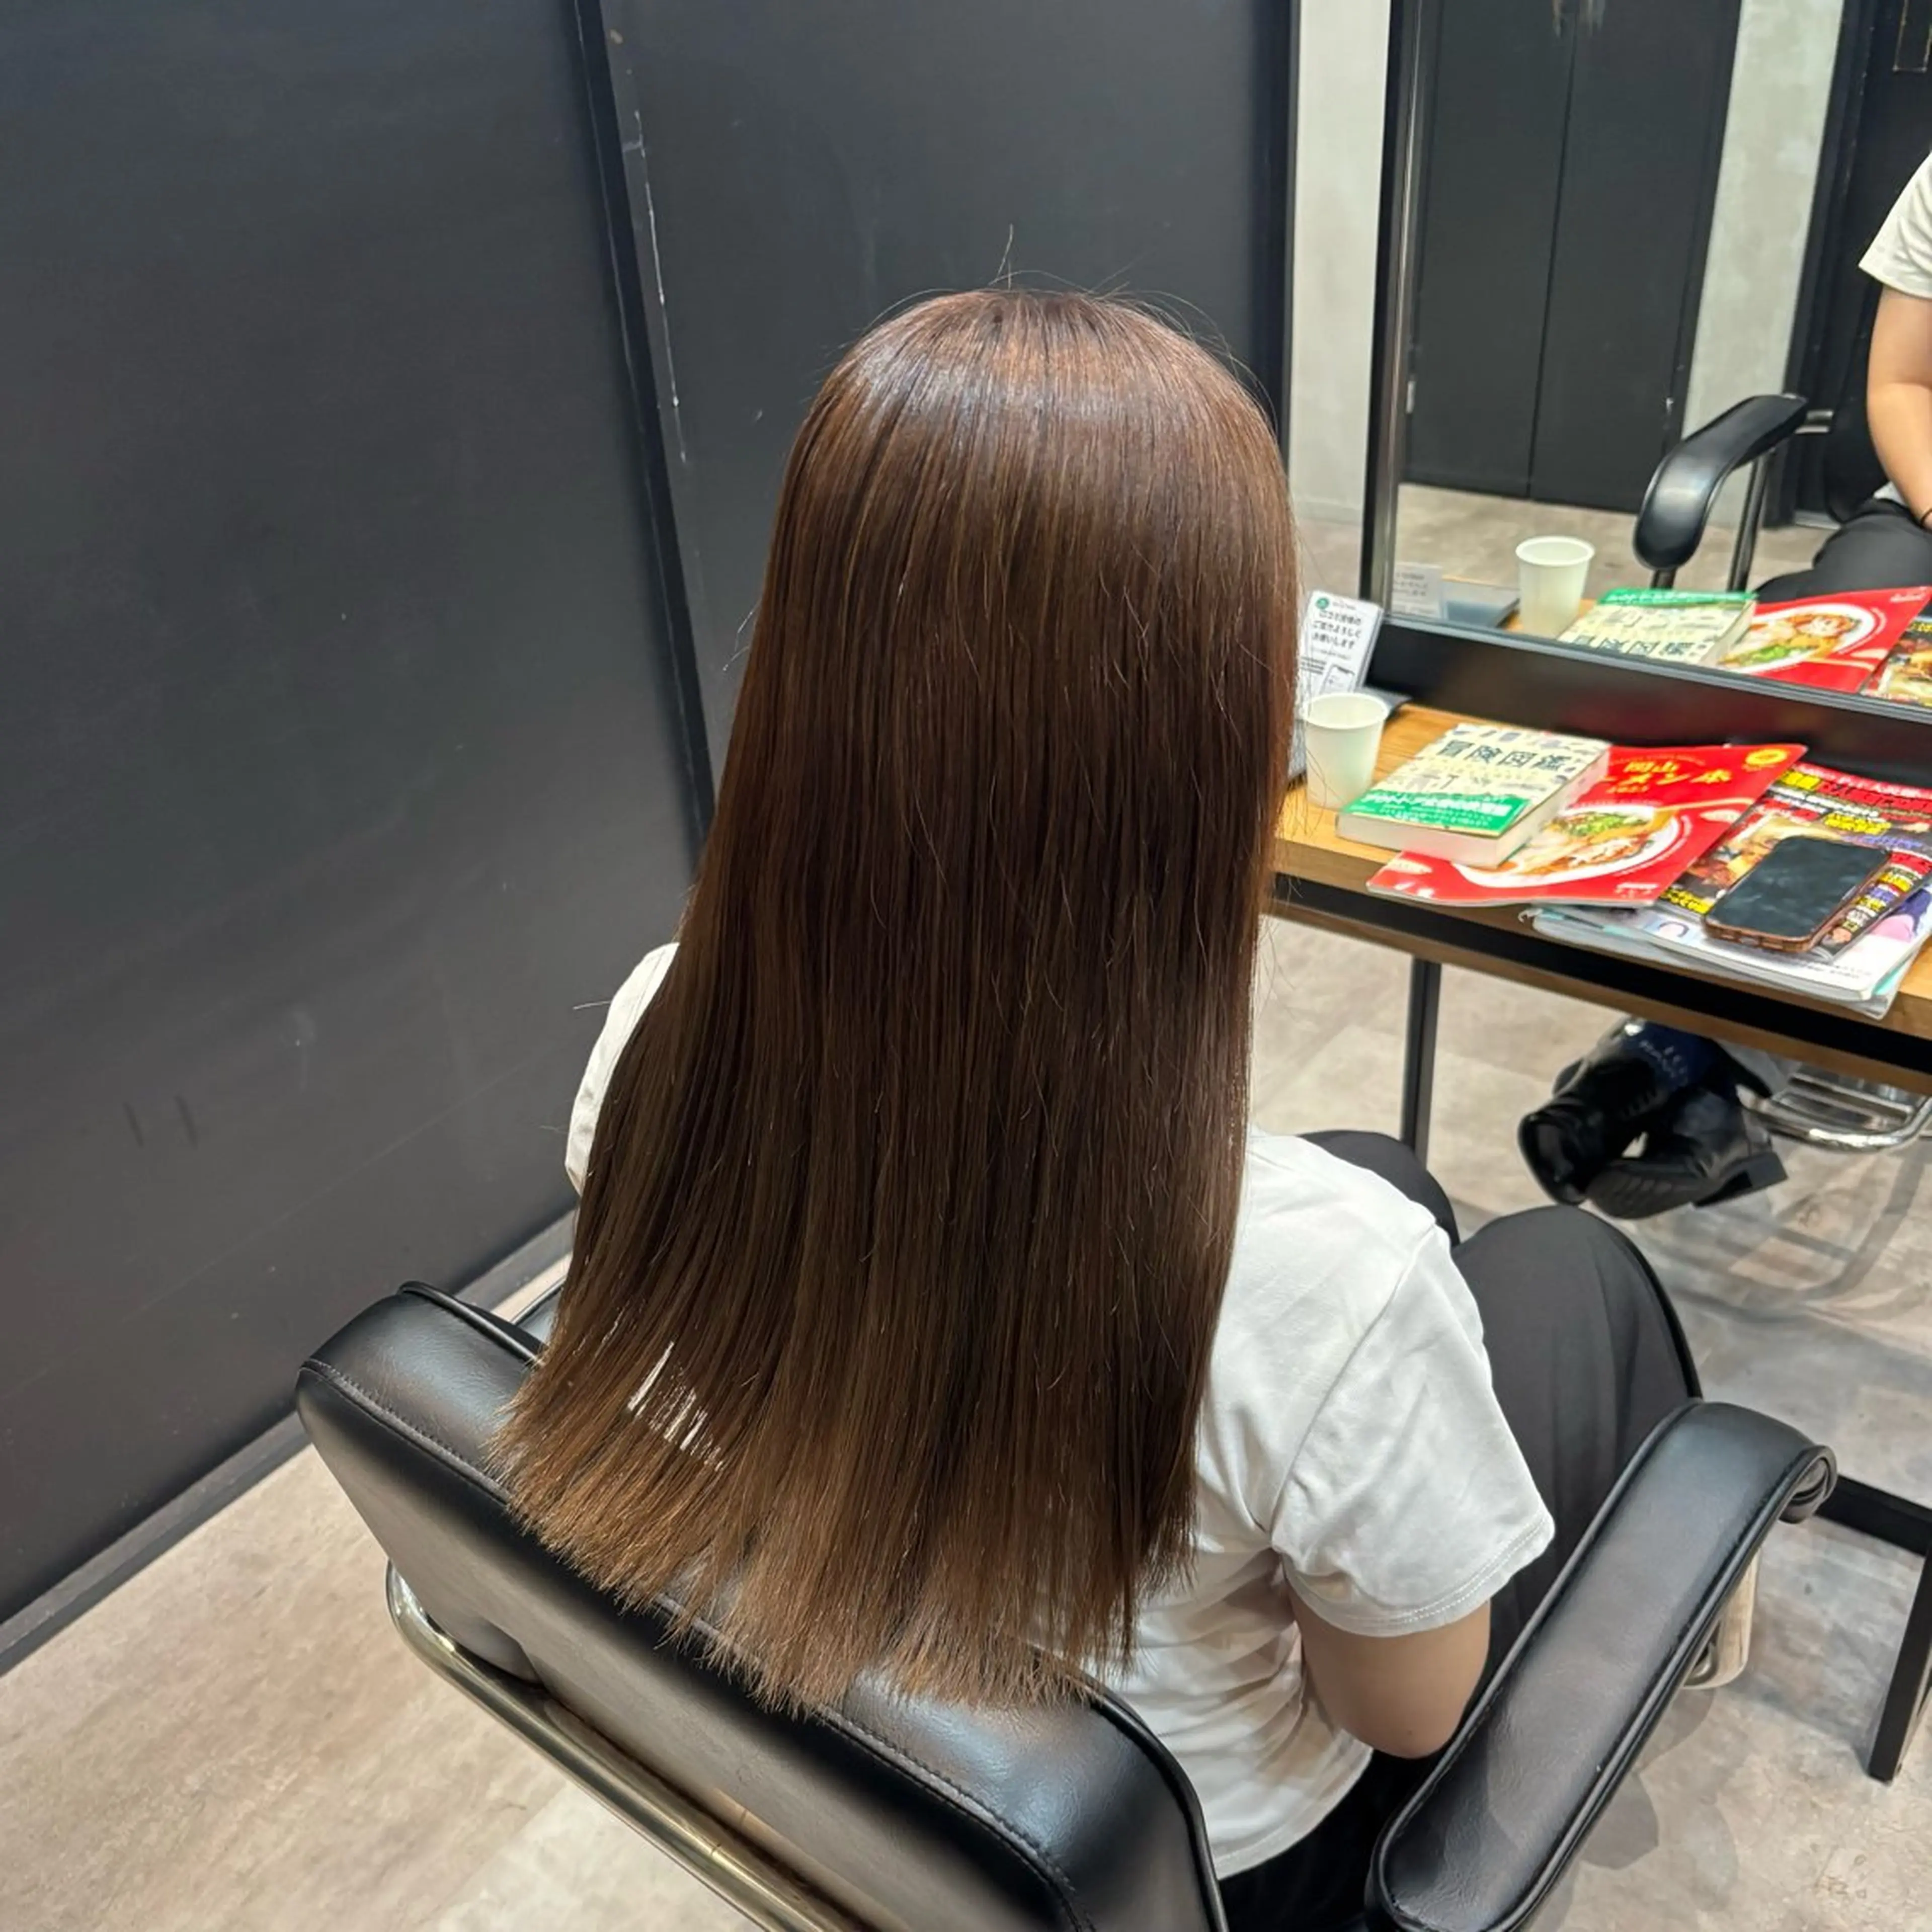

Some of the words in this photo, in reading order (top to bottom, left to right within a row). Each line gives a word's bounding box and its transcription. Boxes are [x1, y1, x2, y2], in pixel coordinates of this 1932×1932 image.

[1312, 632, 1355, 649] お願いします
[1436, 740, 1572, 770] 冒険図鑑
[1623, 761, 1679, 773] 岡山
